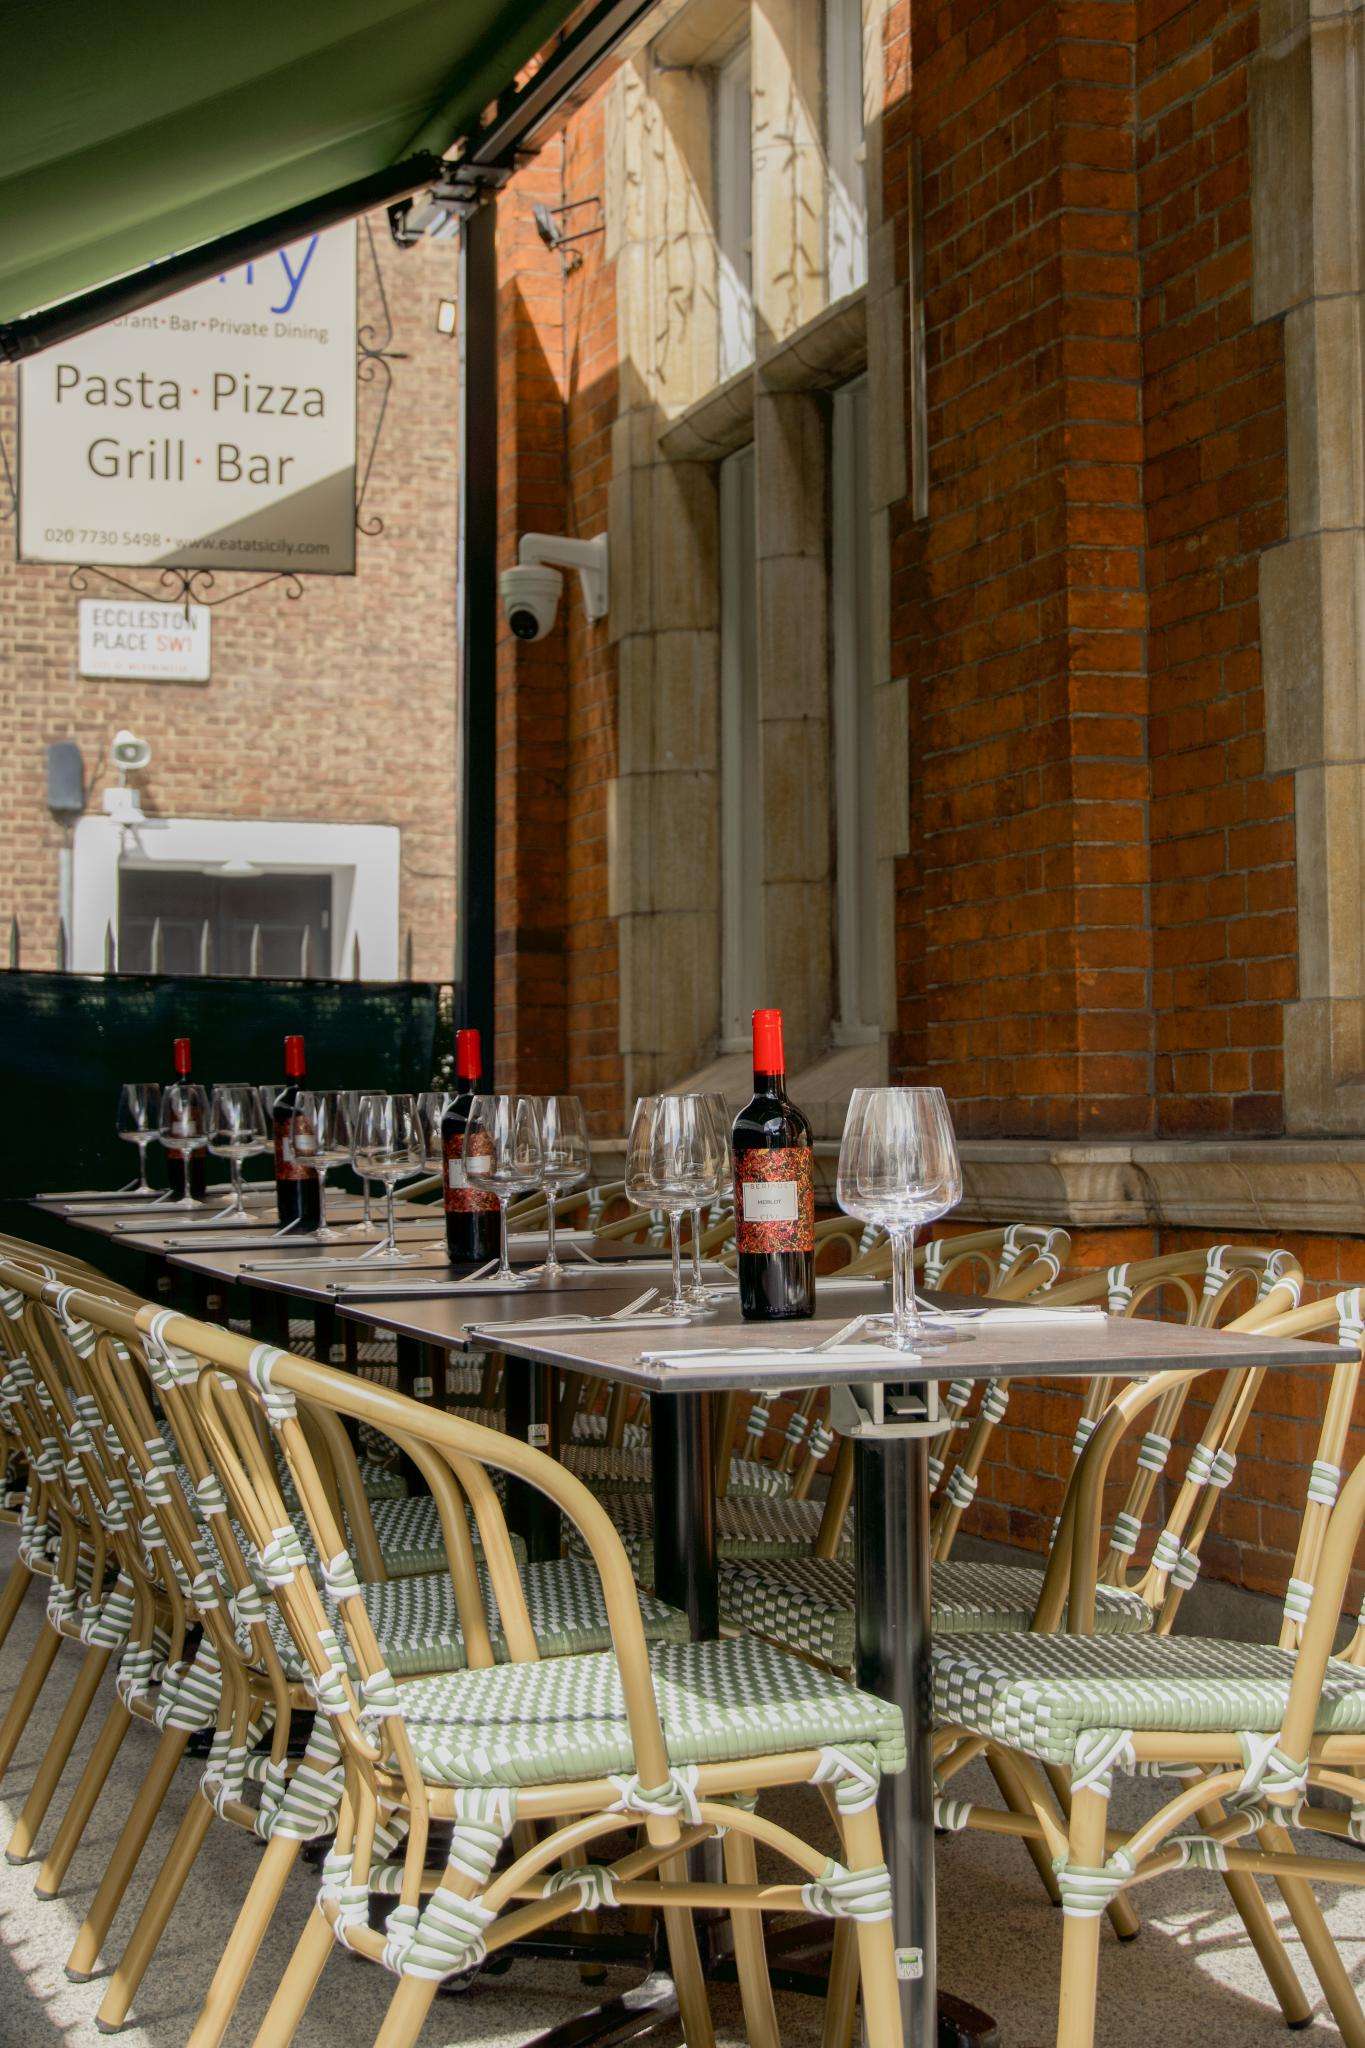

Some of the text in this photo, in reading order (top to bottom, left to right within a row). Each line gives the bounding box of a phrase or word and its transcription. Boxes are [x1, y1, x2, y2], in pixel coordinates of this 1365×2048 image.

[275, 321, 329, 344] Dining
[56, 364, 325, 417] Pasta Pizza
[88, 438, 294, 485] Grill Bar
[44, 528, 74, 543] 020
[79, 529, 118, 545] 7730
[123, 531, 161, 547] 5498
[93, 608, 198, 630] ECCLESTON
[93, 632, 193, 652] PLACE SW1
